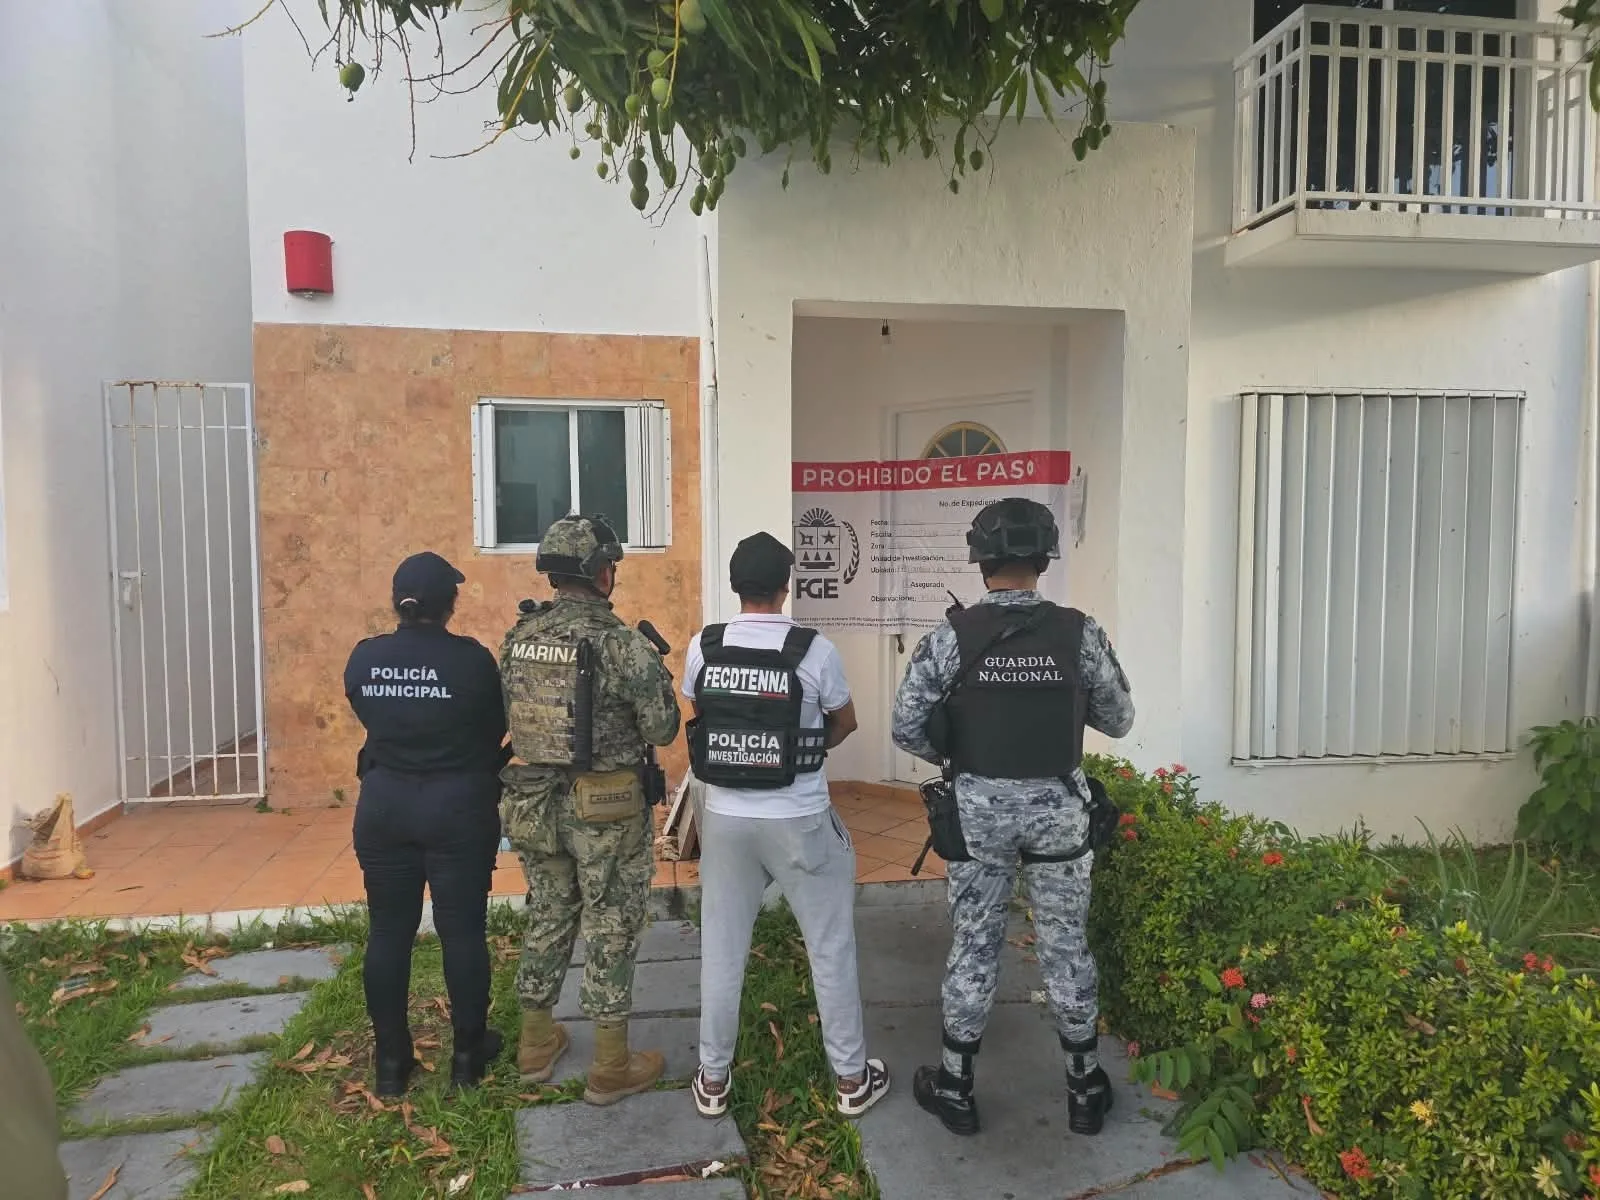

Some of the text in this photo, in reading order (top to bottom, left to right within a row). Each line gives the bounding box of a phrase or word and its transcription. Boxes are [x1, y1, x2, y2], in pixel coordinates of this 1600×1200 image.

[802, 466, 932, 487] PROHIBIDO
[940, 463, 968, 483] EL
[796, 578, 839, 600] FGE
[984, 655, 1056, 668] GUARDIA
[371, 665, 438, 681] POLICÍA
[703, 666, 789, 694] FECDTENNA
[978, 670, 1064, 682] NACIONAL
[361, 684, 452, 698] MUNICIPAL
[708, 732, 781, 750] POLICÍA
[708, 749, 781, 764] INVESTIGACIÓN
